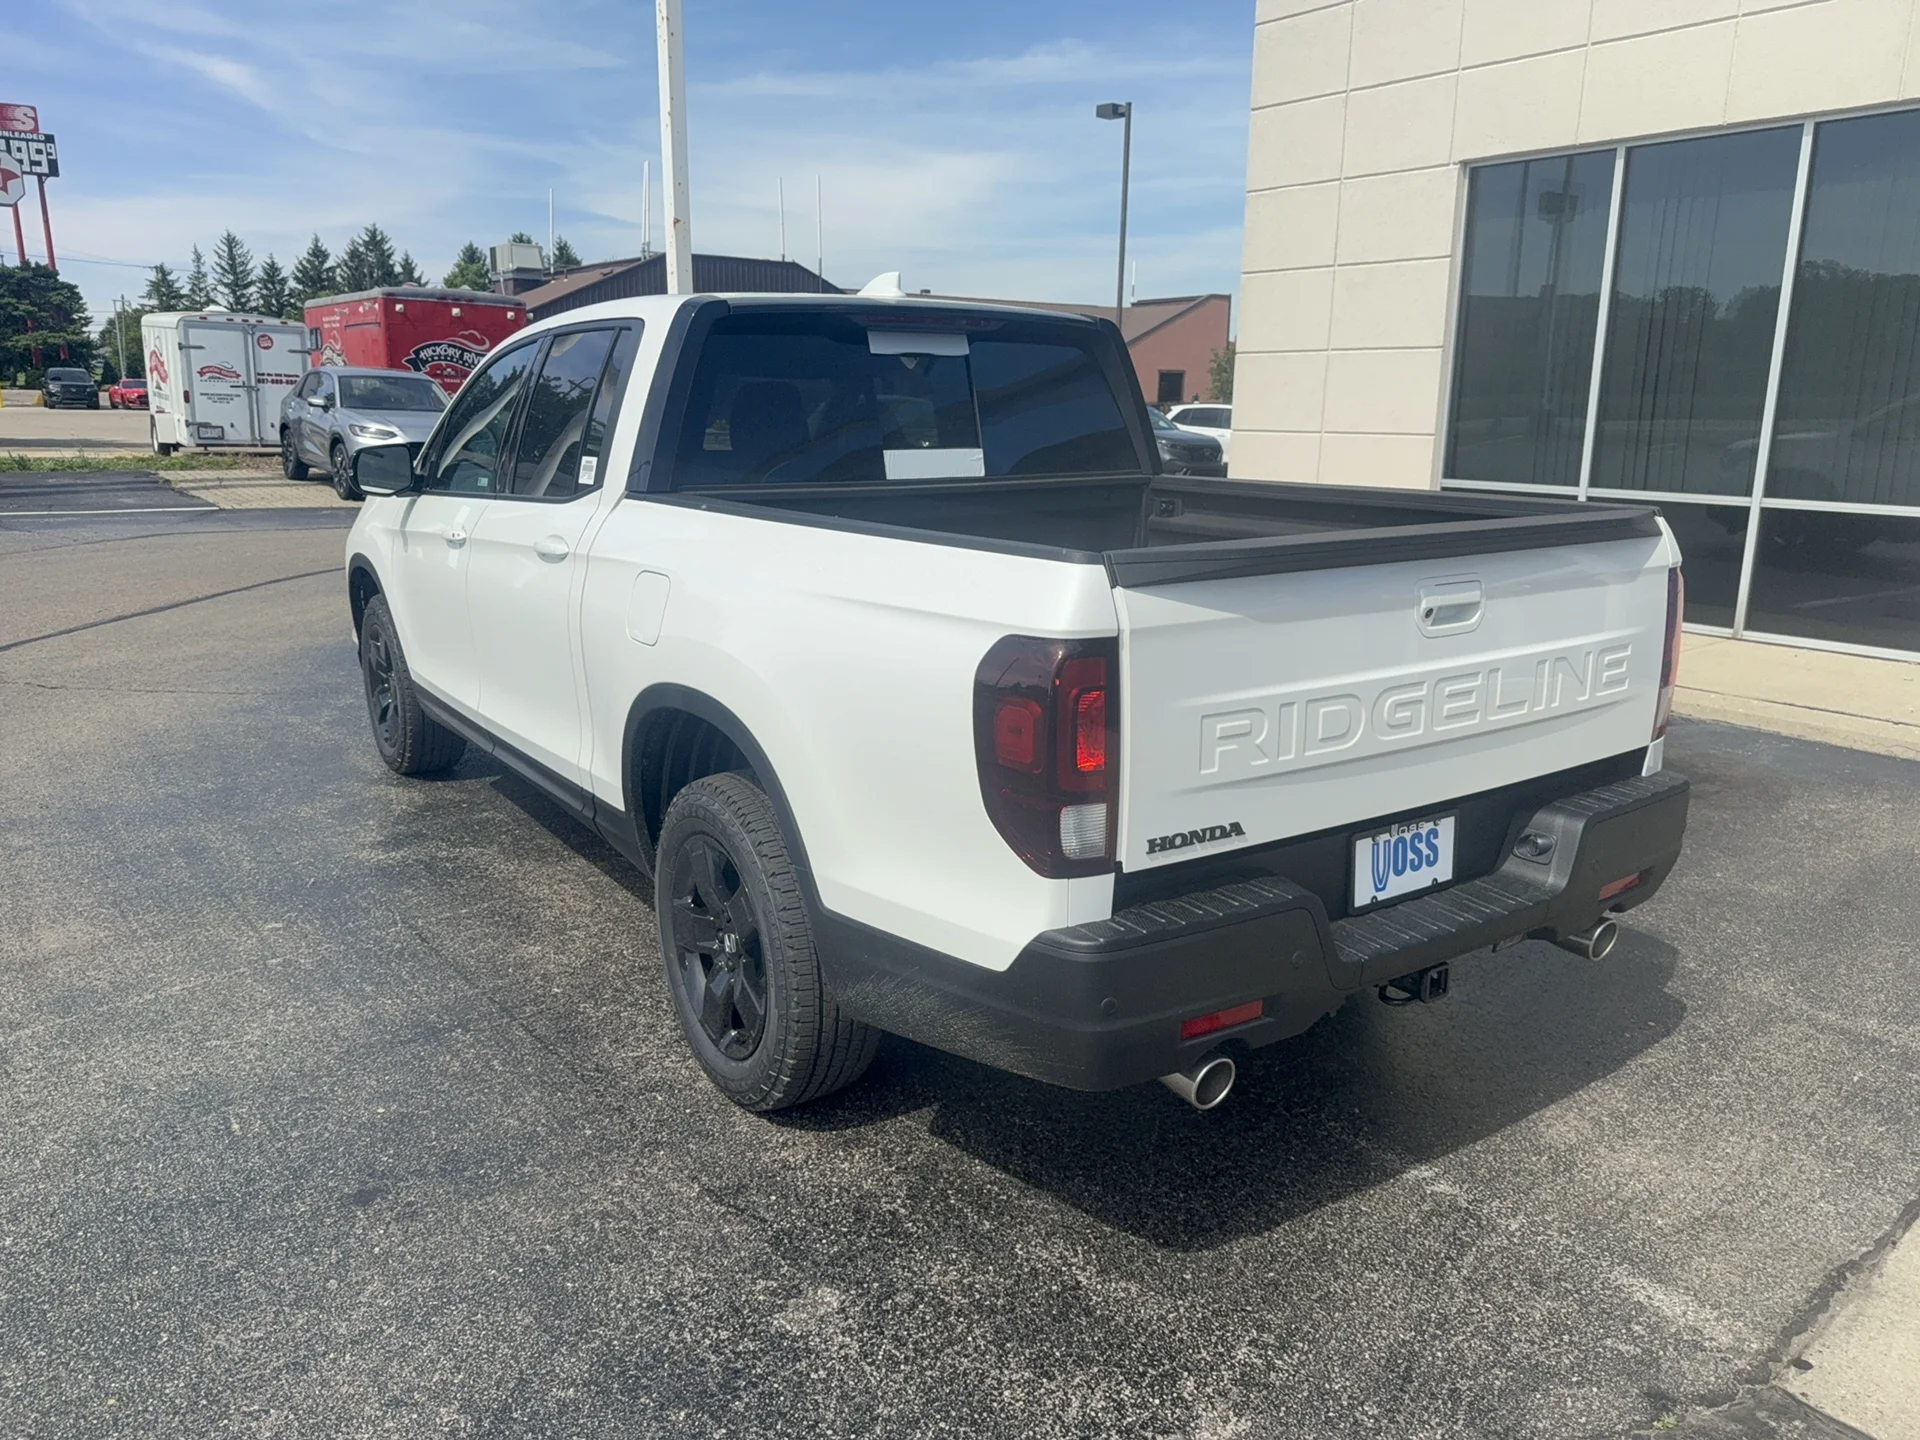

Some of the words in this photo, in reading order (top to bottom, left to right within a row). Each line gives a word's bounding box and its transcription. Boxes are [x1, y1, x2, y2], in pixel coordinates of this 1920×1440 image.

[419, 344, 461, 361] HICKORY
[1199, 643, 1632, 774] RIDGELINE
[1146, 821, 1246, 854] HONDA
[1371, 827, 1439, 893] VOSS
